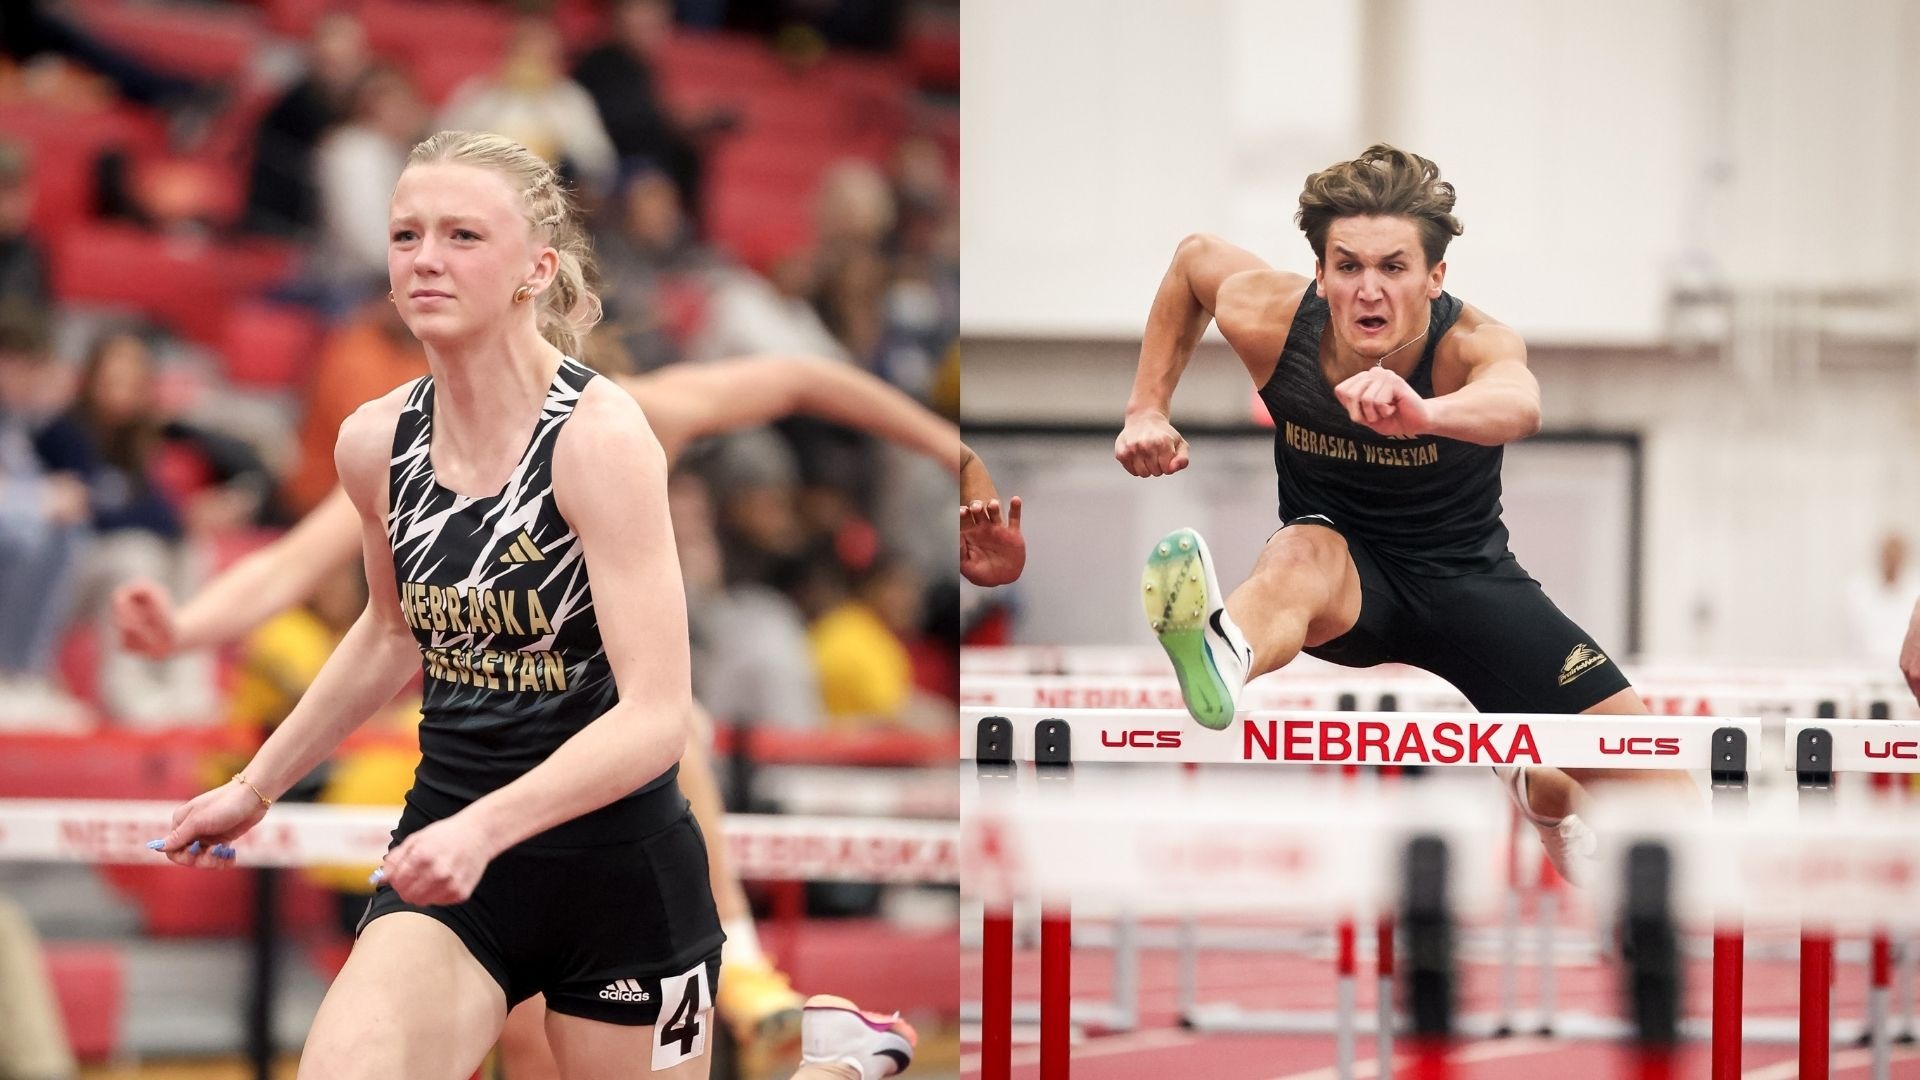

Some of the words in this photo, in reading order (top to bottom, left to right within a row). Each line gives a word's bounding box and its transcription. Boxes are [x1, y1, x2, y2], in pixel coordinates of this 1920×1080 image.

[1286, 421, 1358, 461] NEBRASKA
[1363, 443, 1439, 466] WESLEYAN
[401, 582, 553, 635] NEBRASKA
[424, 648, 568, 692] WESLEYAN
[1101, 730, 1181, 749] UCS
[1243, 720, 1543, 764] NEBRASKA
[1599, 737, 1680, 755] UCS
[1864, 740, 1919, 759] UC
[599, 988, 650, 1002] adidas
[660, 974, 700, 1056] 4
